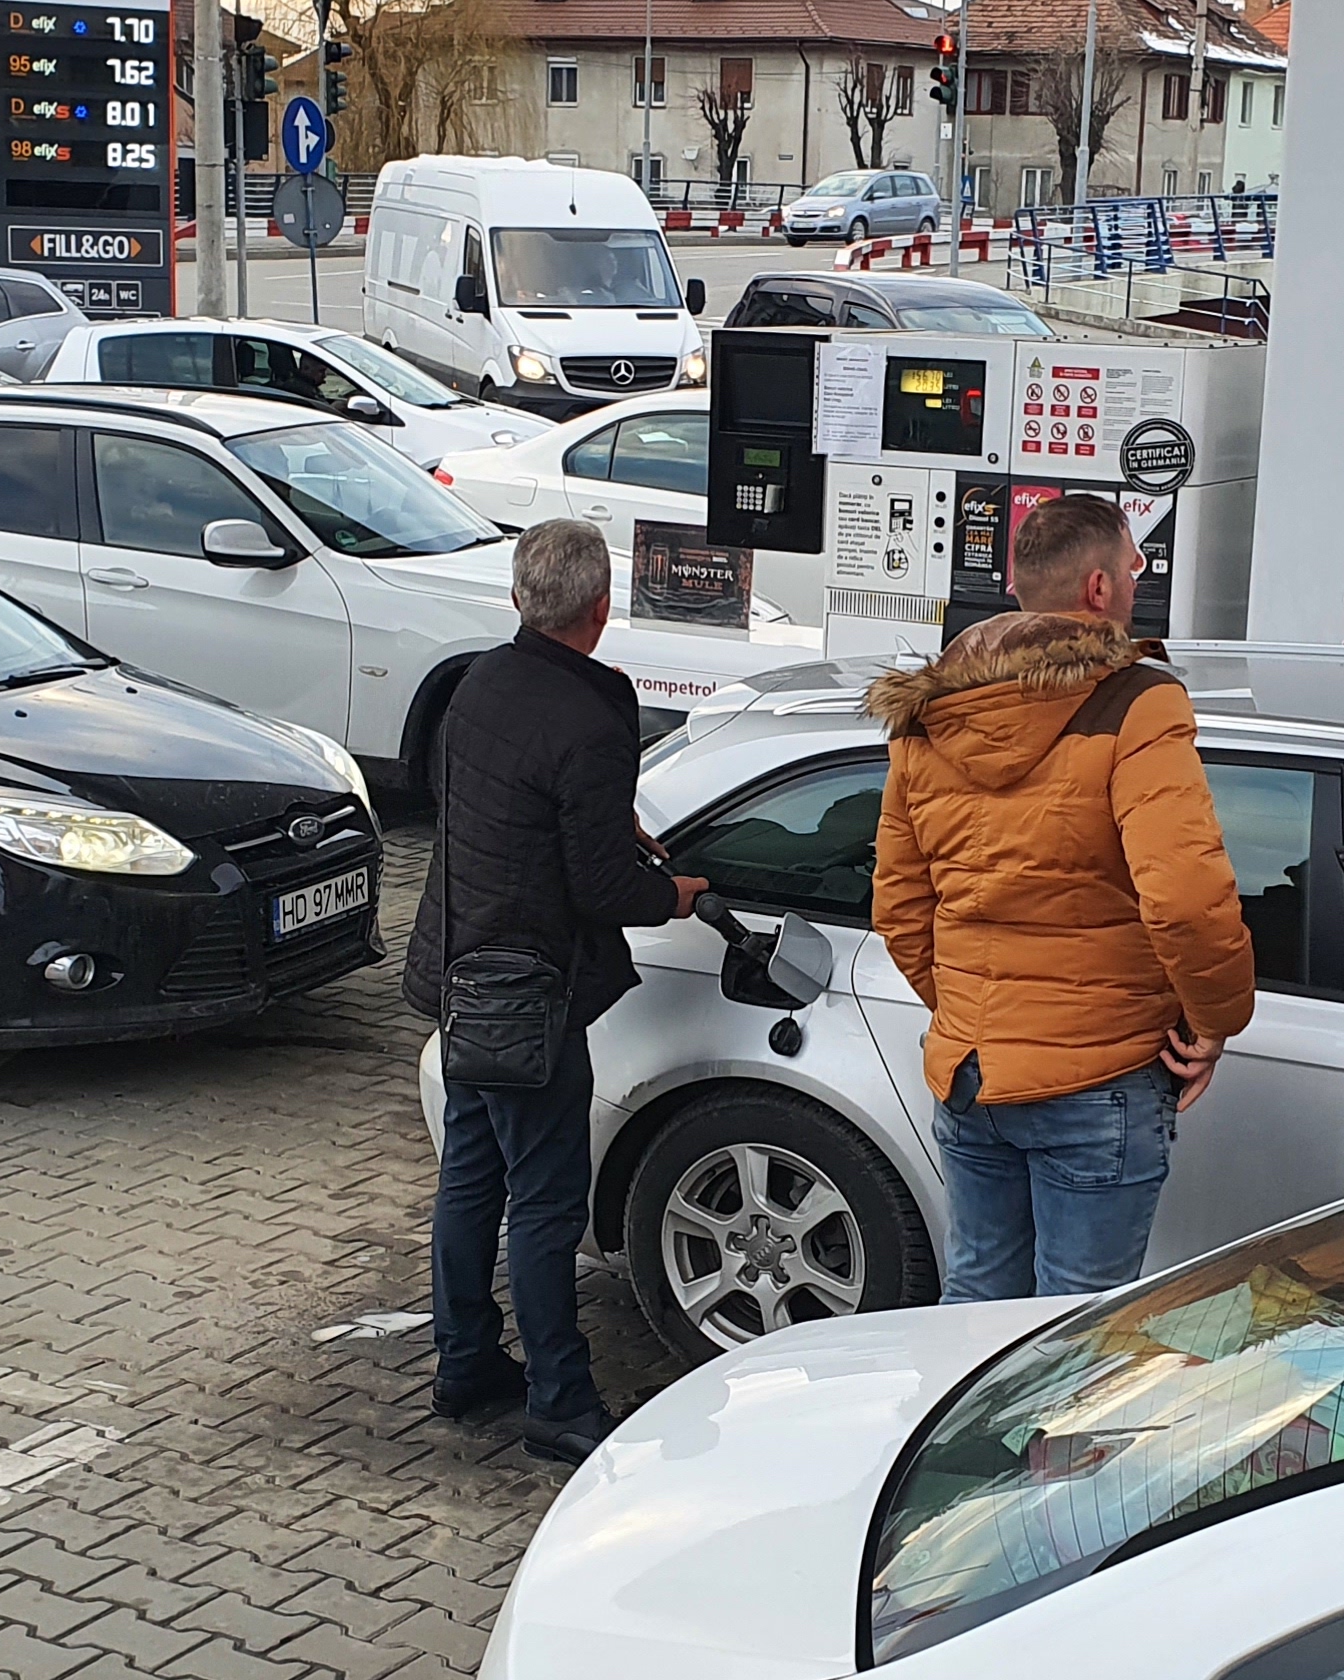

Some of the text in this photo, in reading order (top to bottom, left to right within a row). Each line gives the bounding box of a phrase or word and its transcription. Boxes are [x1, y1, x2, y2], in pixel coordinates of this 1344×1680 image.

[10, 12, 154, 43] D efix 7.70
[9, 55, 154, 85] 95 efix 7.62
[11, 98, 24, 114] D
[11, 141, 32, 156] 98
[107, 143, 155, 168] 8.25
[43, 234, 129, 259] FILL&GO
[119, 290, 137, 300] WC
[1128, 445, 1186, 460] CERTIFICAT
[1141, 457, 1186, 468] GERMANIA
[1123, 498, 1155, 516] efix
[671, 564, 734, 582] MONSTER
[681, 578, 723, 590] MULE
[636, 677, 717, 699] rompetrol
[282, 894, 306, 929] HD
[313, 883, 332, 917] 97
[335, 872, 366, 910] MMR
